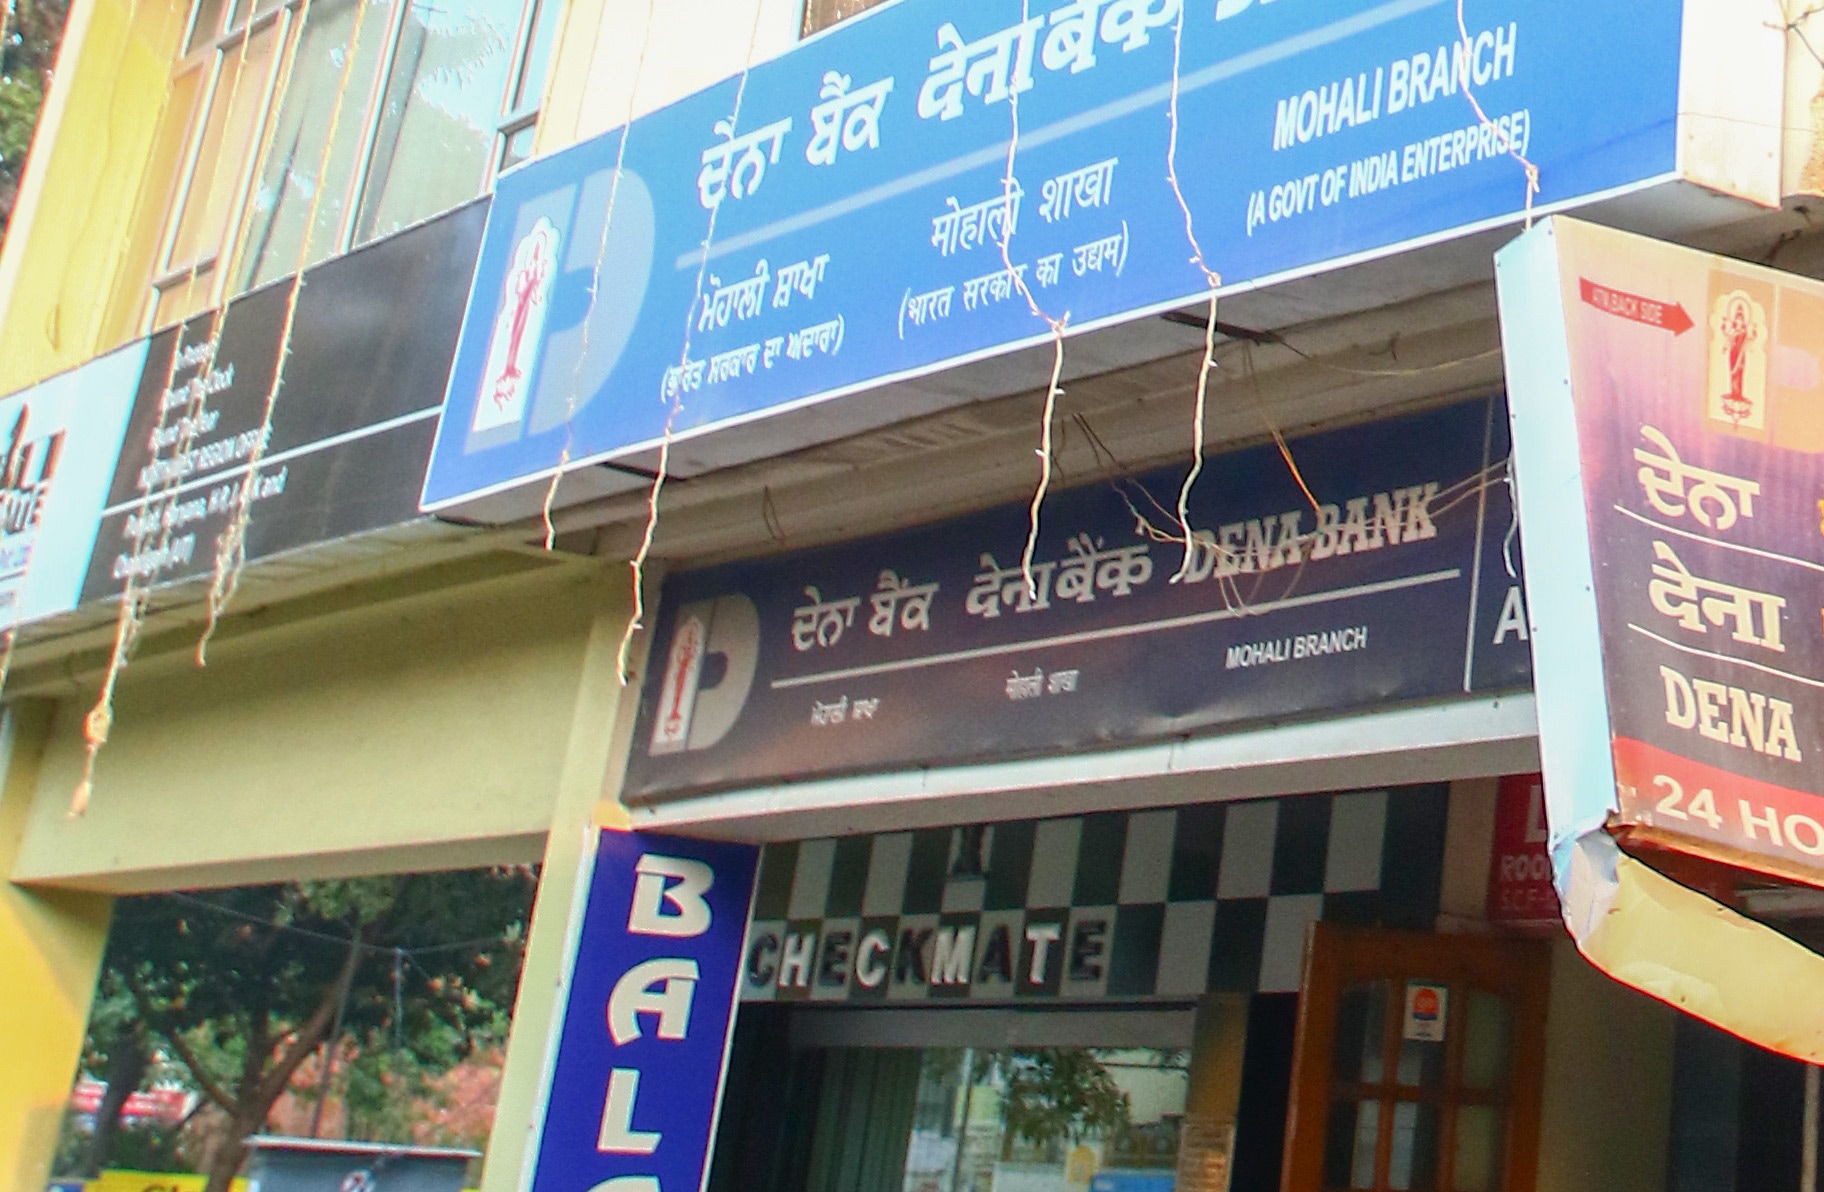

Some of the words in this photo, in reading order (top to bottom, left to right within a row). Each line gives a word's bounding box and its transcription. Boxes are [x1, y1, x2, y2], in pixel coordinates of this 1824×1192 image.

[1273, 67, 1384, 151] MOHALI
[1387, 21, 1517, 115] BRANCH
[697, 116, 793, 209] ਦੇਨਾ
[931, 177, 1025, 256] मोहाली
[1038, 156, 1119, 223] शाखा
[1268, 173, 1319, 223] GOVT
[1321, 165, 1350, 208] OF
[1349, 150, 1399, 198] INDIA
[1401, 108, 1531, 184] ENTERPRISE)
[963, 263, 1029, 312] सरकार
[1036, 252, 1064, 288] का
[763, 336, 785, 369] ਦਾ
[1633, 425, 1761, 531] ਦੇਨਾ
[1183, 510, 1303, 584] DENA
[1310, 482, 1439, 561] BANK
[791, 585, 861, 651] ਦੇਨਾ
[1649, 540, 1786, 653] देना
[1225, 640, 1292, 669] MOHALI
[1293, 627, 1368, 659] BRANCH
[1659, 665, 1802, 762] DENA
[1651, 774, 1723, 830] 24
[746, 919, 1107, 988] CHECKMATE
